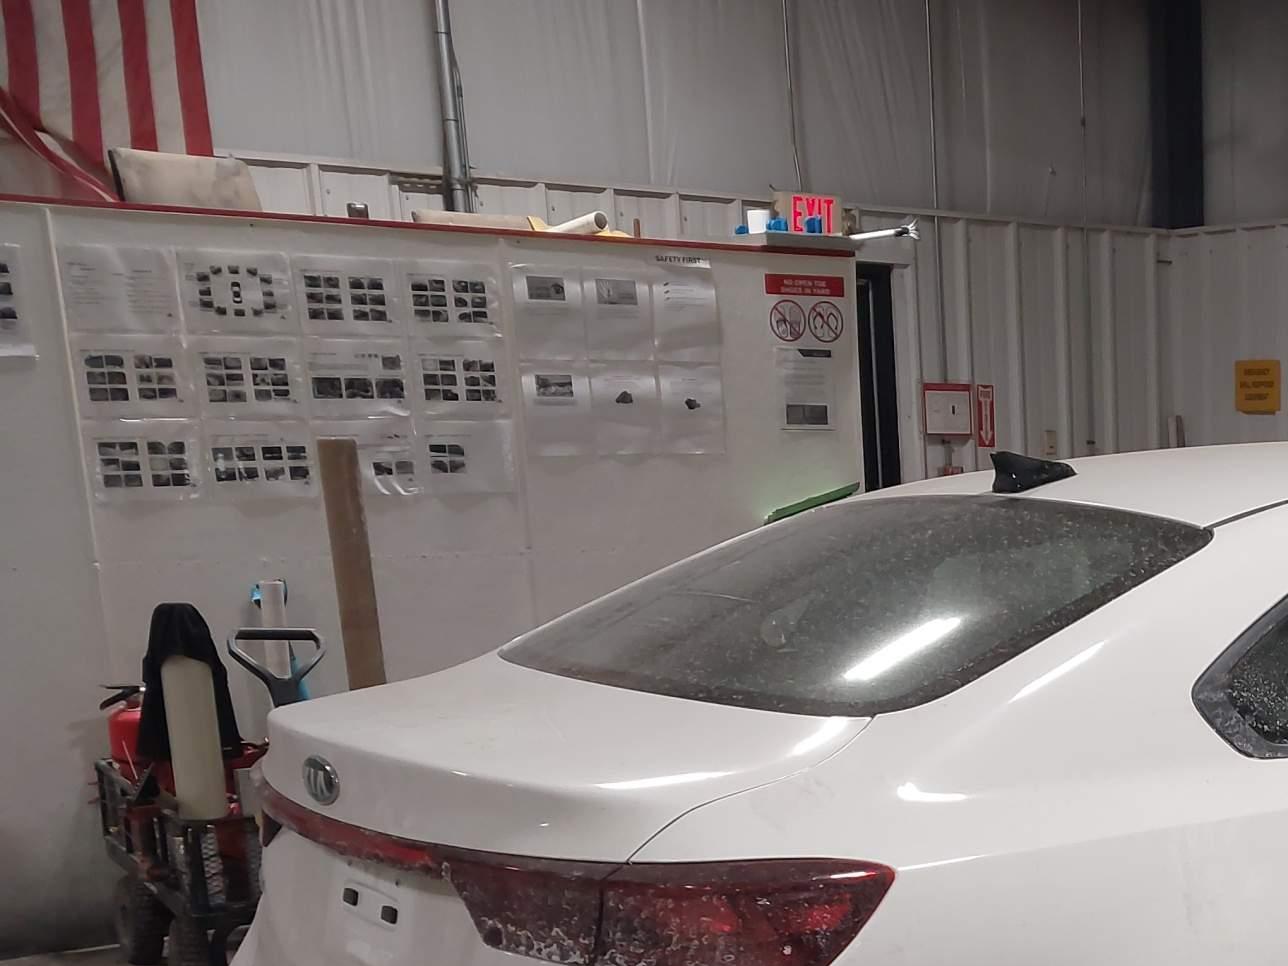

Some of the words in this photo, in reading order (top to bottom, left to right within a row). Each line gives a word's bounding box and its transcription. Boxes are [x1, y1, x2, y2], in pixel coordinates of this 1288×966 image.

[791, 195, 834, 235] EXIT
[655, 255, 681, 263] SAFETY
[682, 256, 702, 264] FIRST
